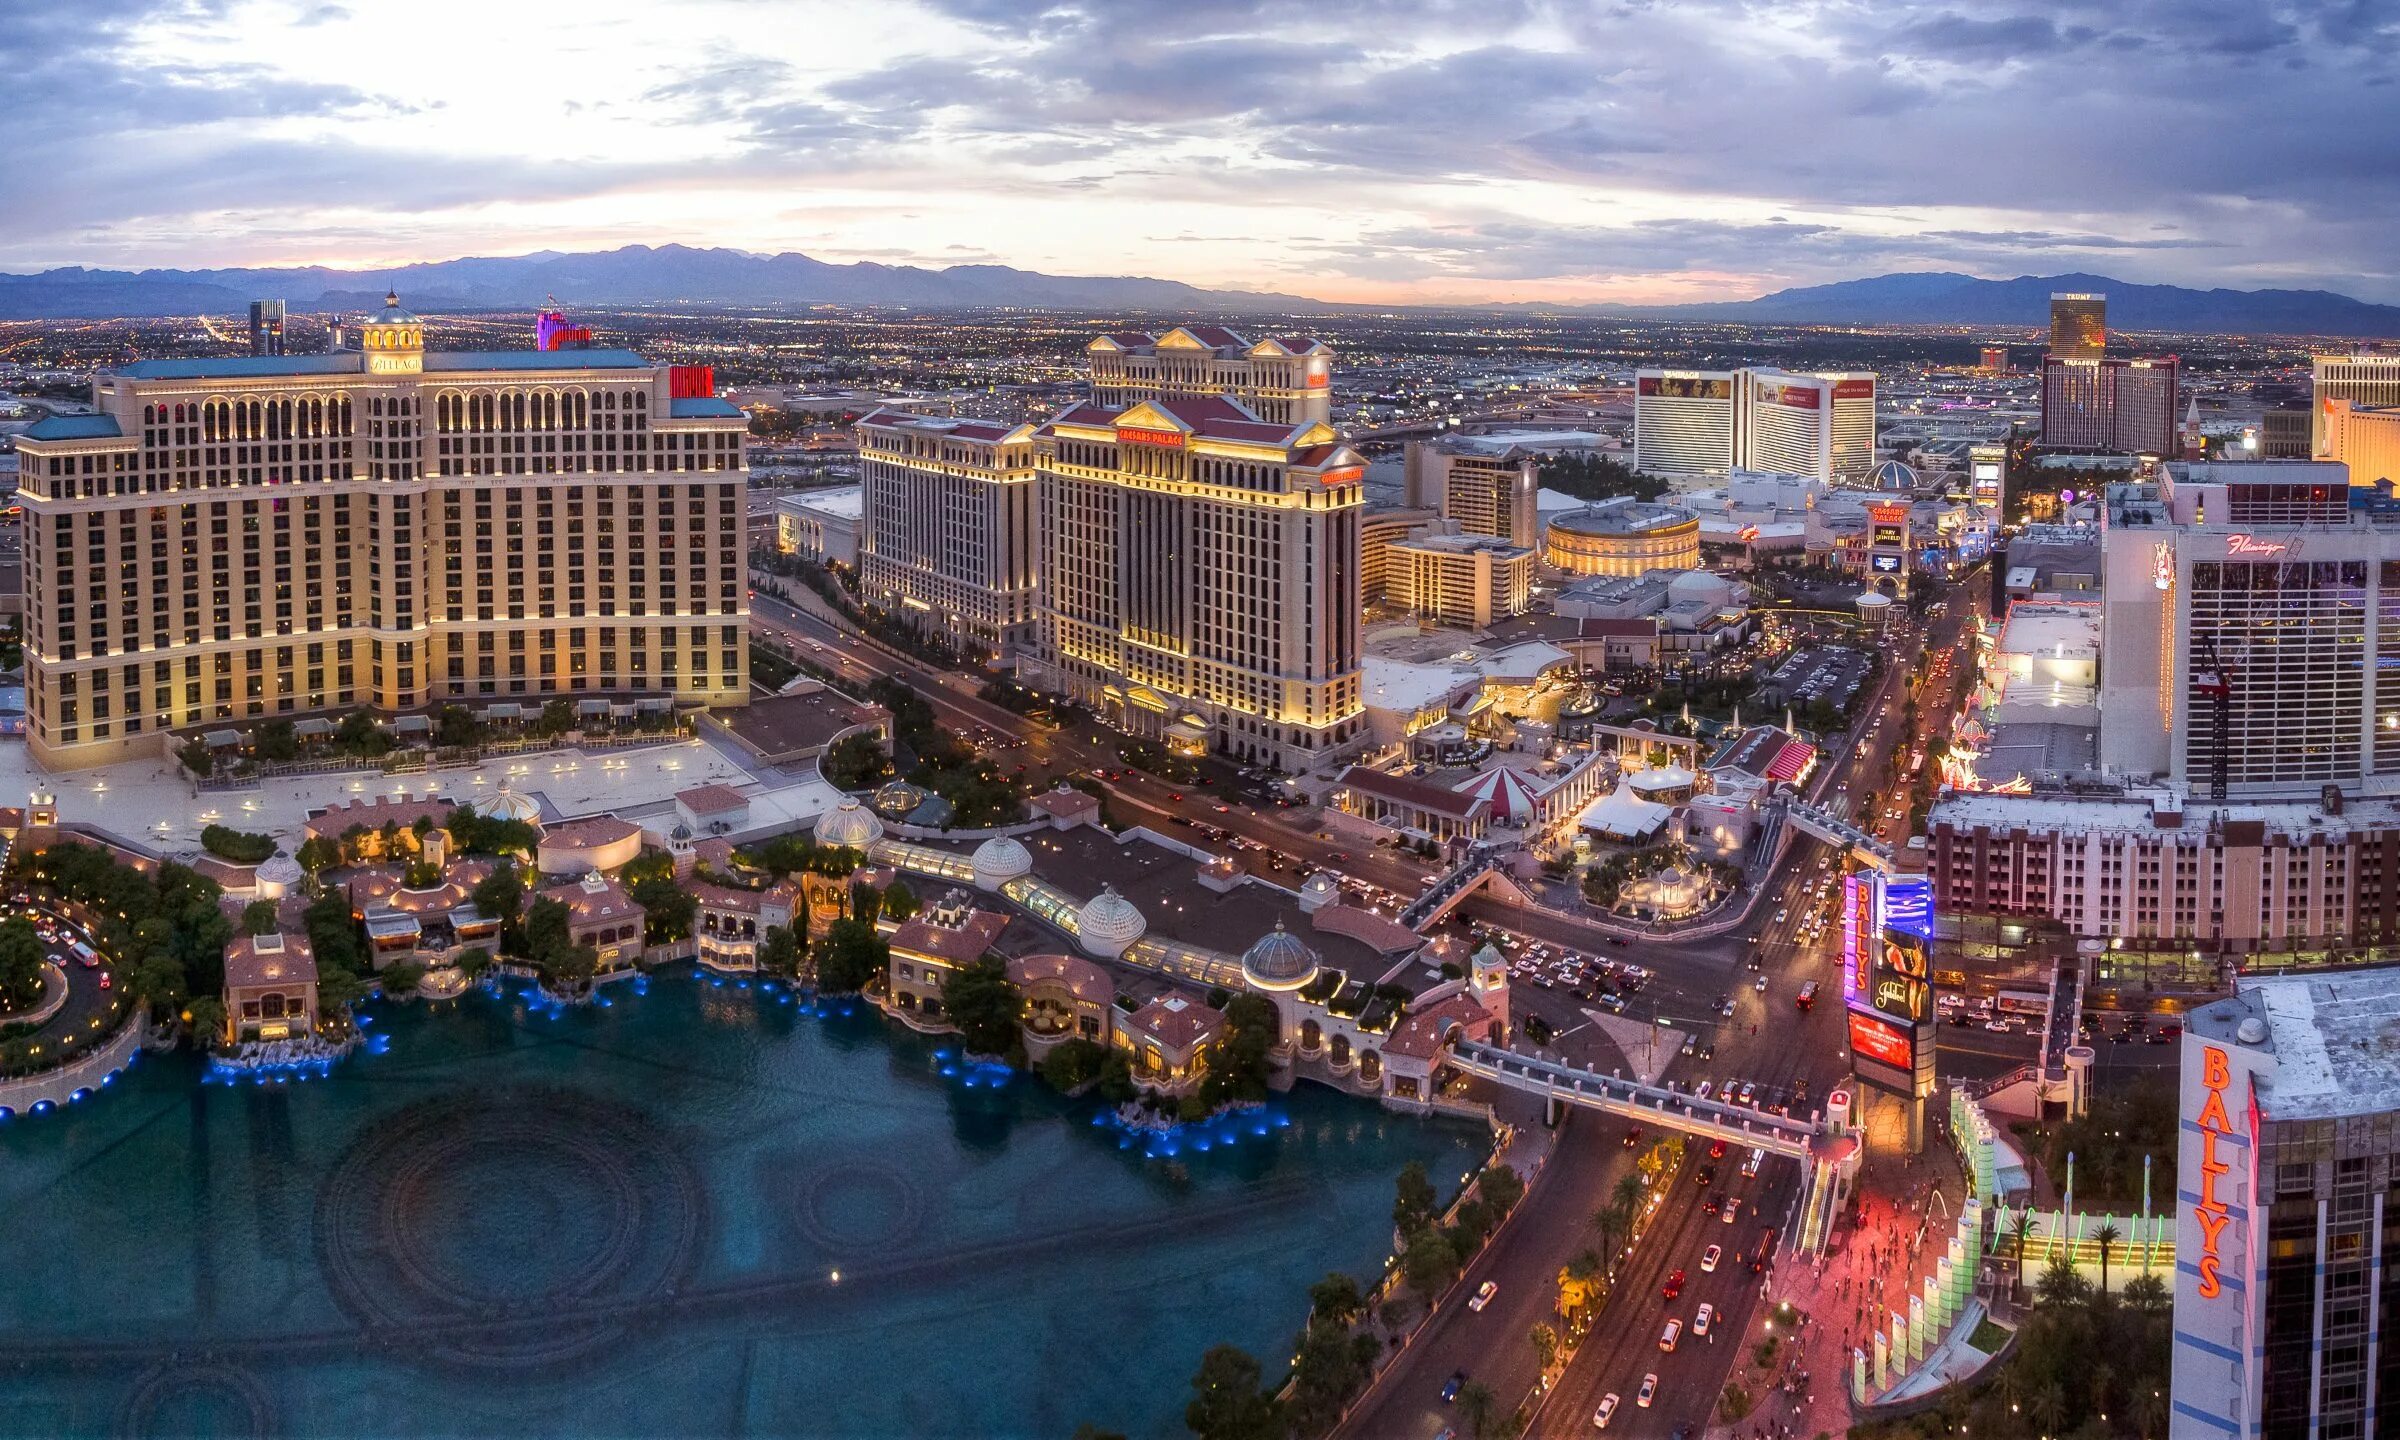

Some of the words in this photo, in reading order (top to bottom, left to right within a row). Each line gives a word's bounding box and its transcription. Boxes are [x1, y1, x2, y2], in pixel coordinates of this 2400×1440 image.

[2131, 361, 2152, 369] ISLAND
[2351, 356, 2400, 365] VENETIAN
[1671, 370, 1699, 379] MIRAGE
[1119, 429, 1151, 442] CAESARS
[1152, 433, 1183, 446] PALACE
[1979, 447, 2006, 456] MIRAGE
[1873, 508, 1904, 516] CAESARS
[2226, 535, 2285, 556] Flamingo
